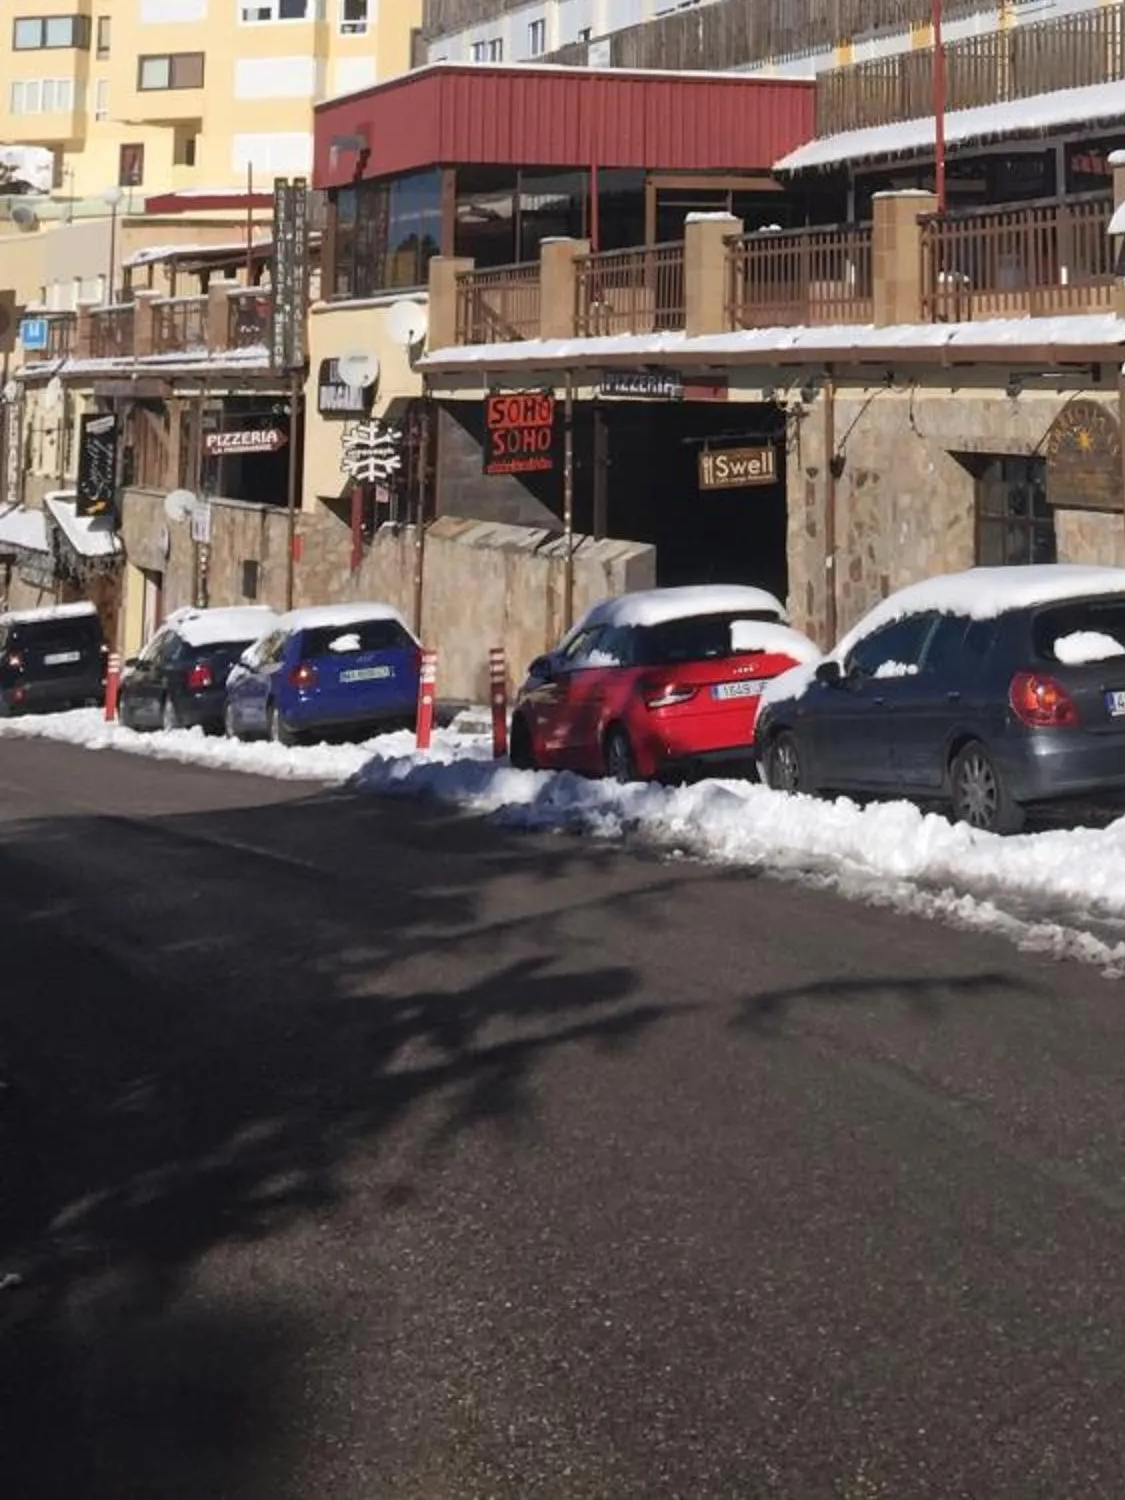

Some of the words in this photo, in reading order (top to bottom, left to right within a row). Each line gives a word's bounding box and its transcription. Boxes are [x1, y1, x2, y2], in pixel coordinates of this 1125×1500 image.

[491, 399, 550, 425] SOHO
[206, 429, 278, 449] PIZZERIA
[493, 427, 551, 455] SOHO
[715, 451, 773, 477] Swell
